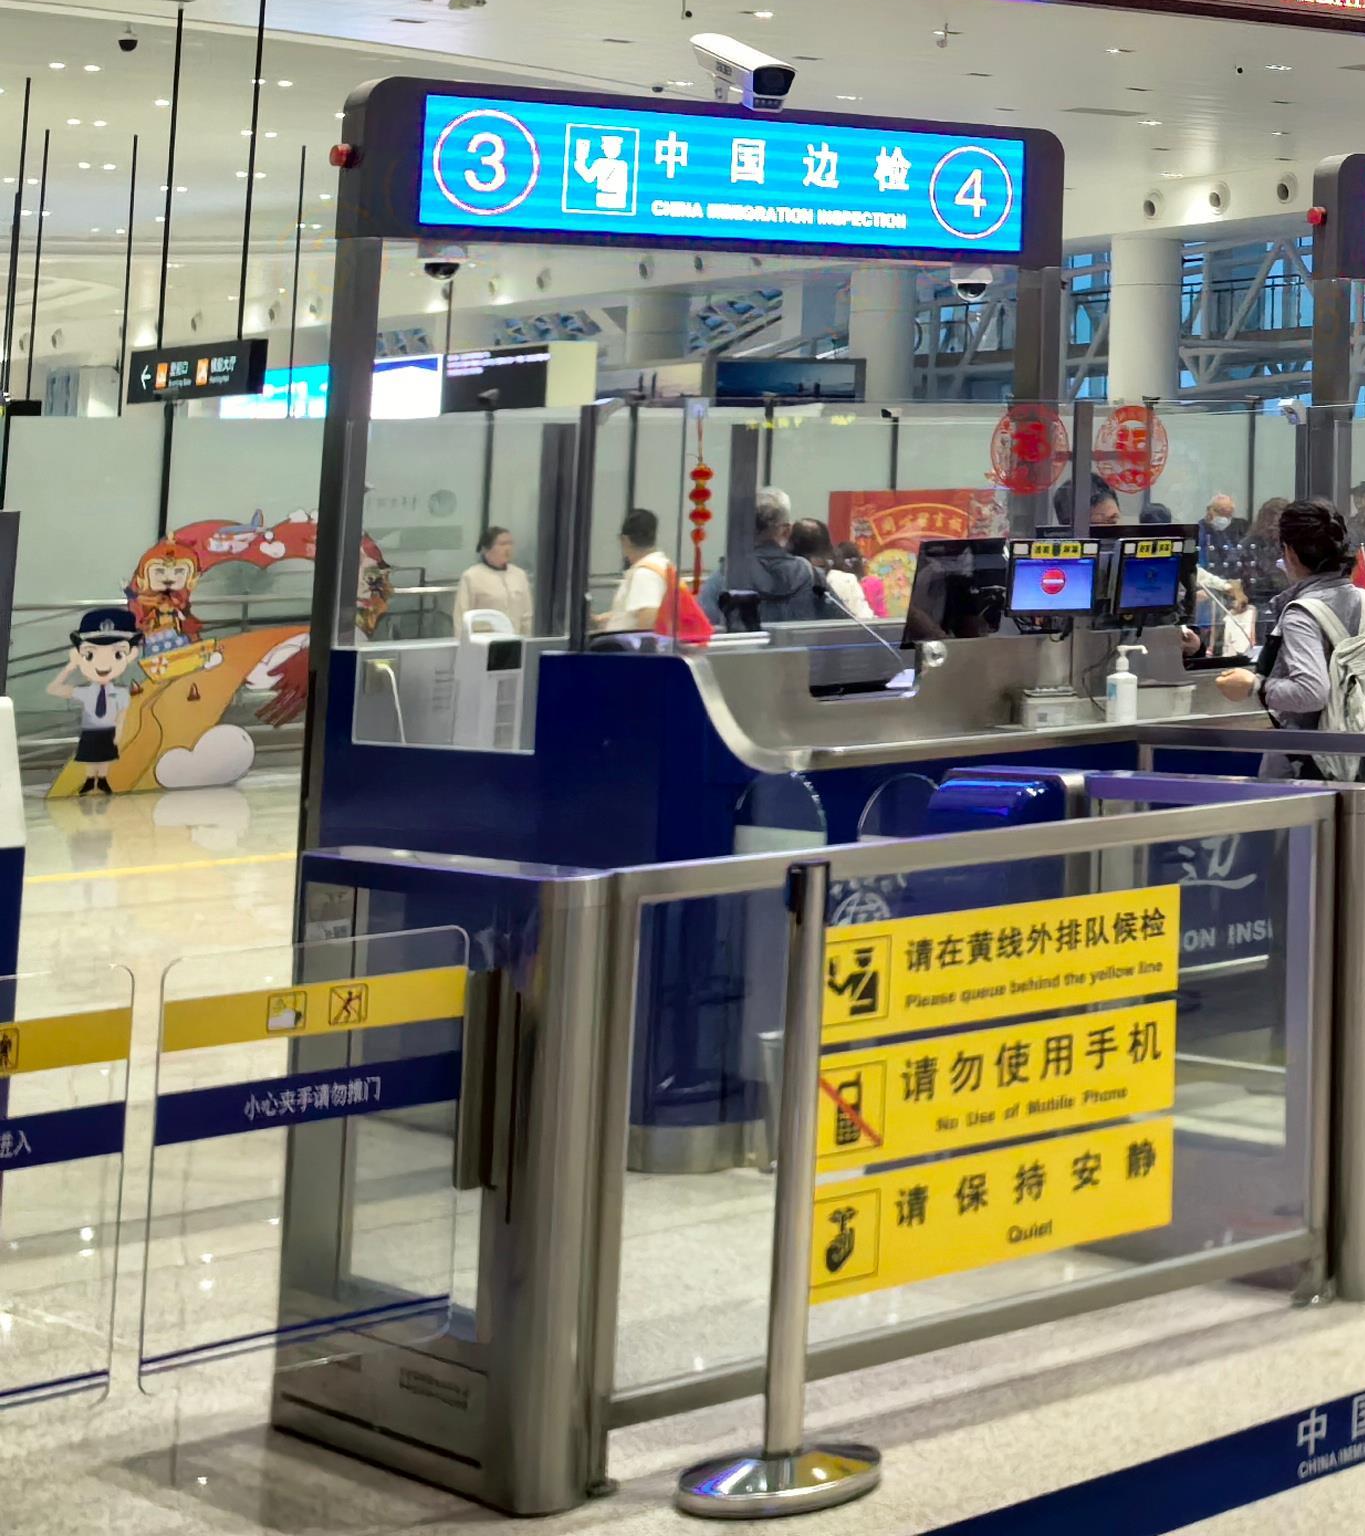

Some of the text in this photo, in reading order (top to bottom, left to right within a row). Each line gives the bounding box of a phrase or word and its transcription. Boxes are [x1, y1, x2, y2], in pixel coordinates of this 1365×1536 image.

[463, 131, 509, 193] 3
[654, 130, 911, 193] 中国边检
[953, 169, 988, 217] 4
[905, 906, 1167, 973] 请在黄线外排队候检
[905, 960, 1164, 1010] Please queue behind the yellow line
[901, 1020, 1162, 1104] 请勿使用手机
[895, 1138, 1157, 1229] 请保持安静
[1007, 1219, 1054, 1246] Quiet
[1297, 1448, 1338, 1479] CHINA
